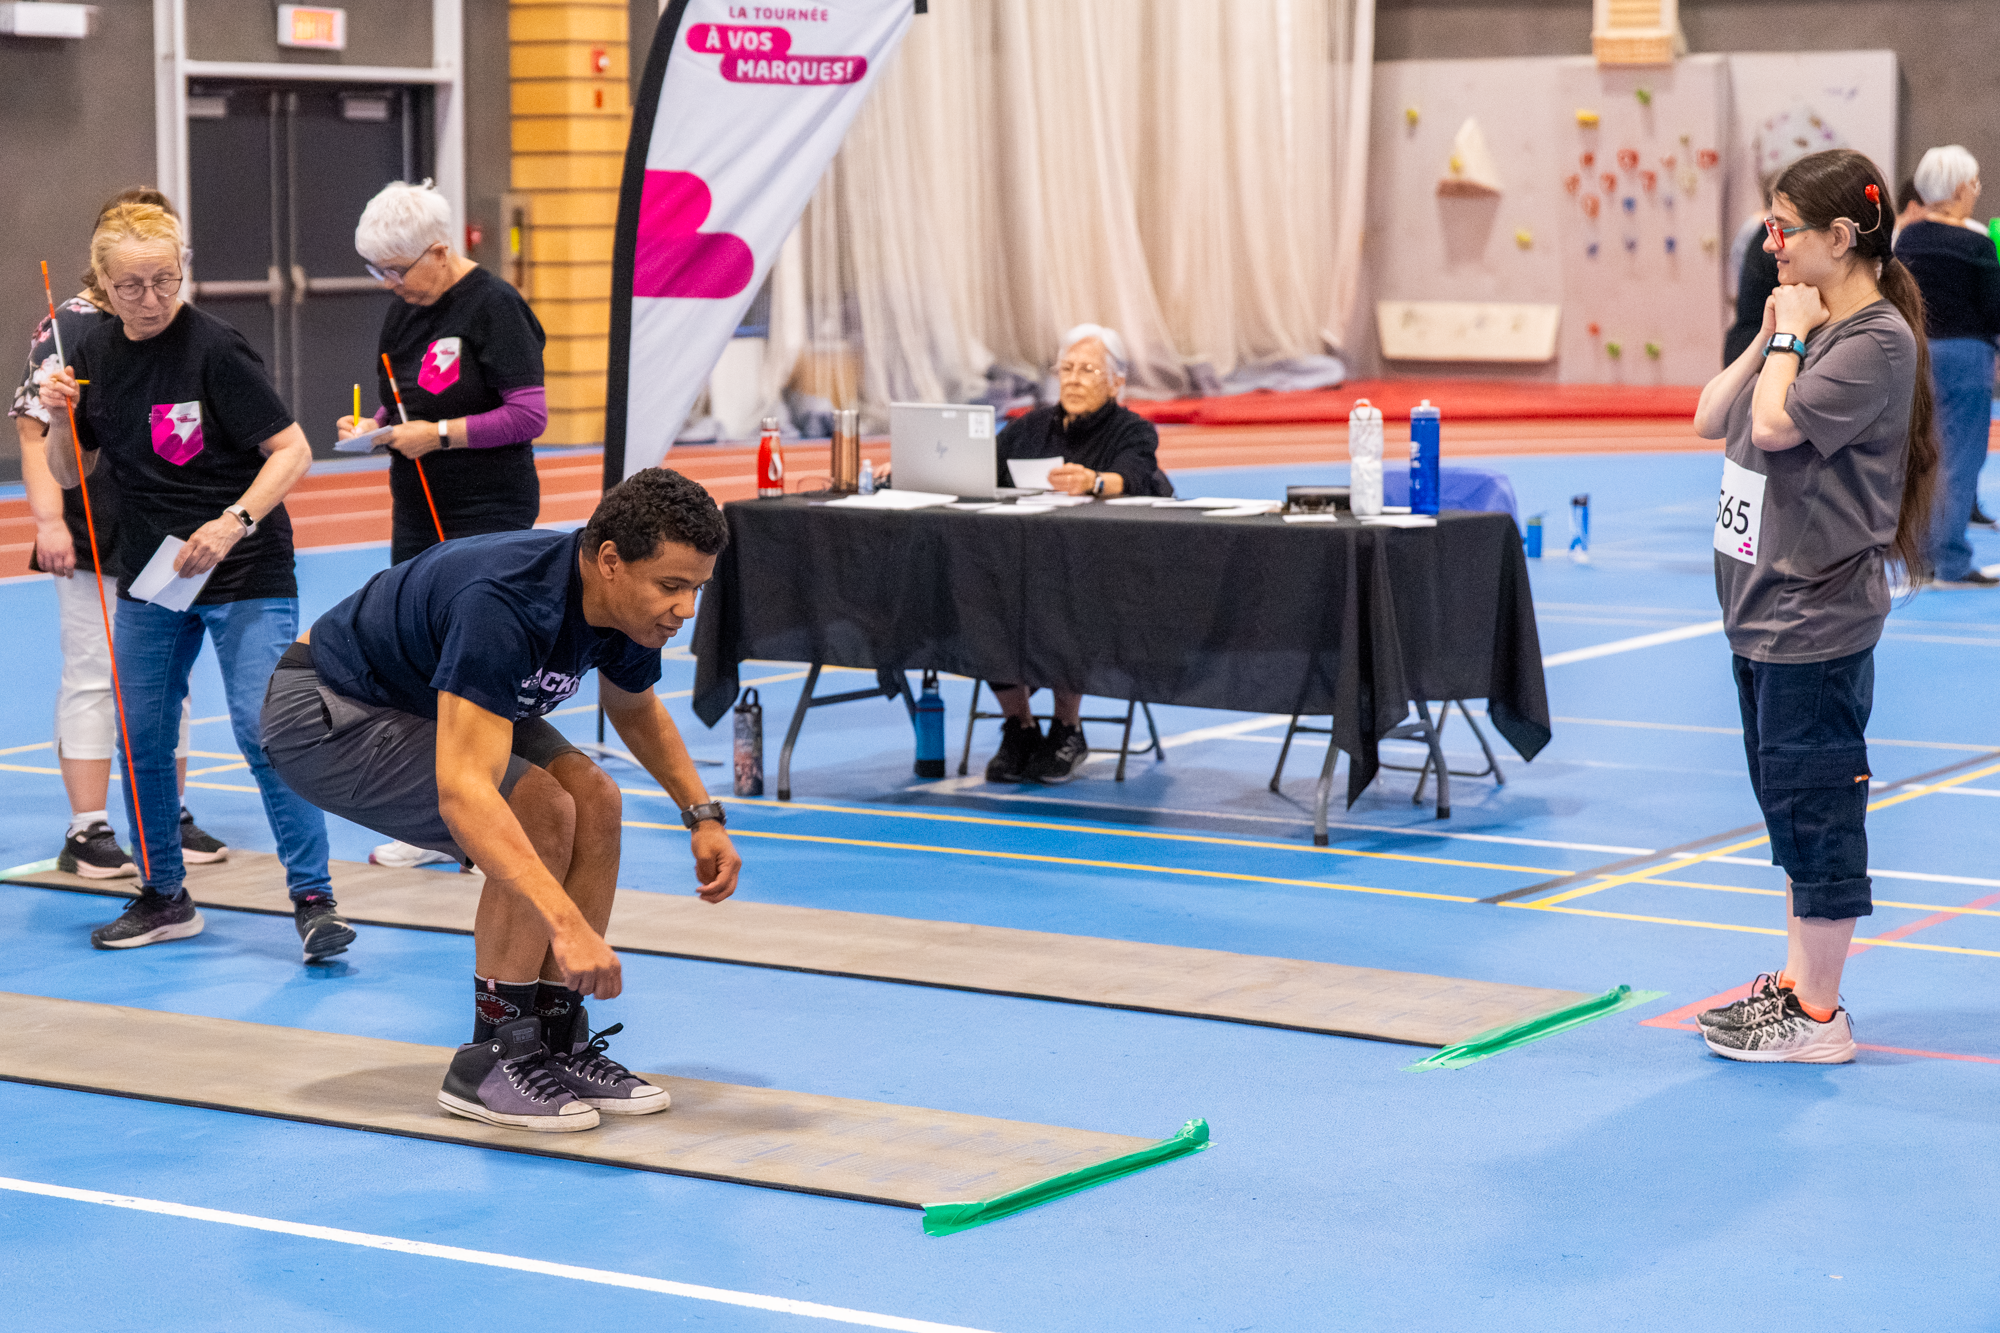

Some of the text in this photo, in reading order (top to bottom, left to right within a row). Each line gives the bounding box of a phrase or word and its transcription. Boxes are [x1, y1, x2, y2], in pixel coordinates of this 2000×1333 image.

[729, 6, 829, 22] LA TOURNÉE
[705, 25, 774, 51] À VOS
[736, 59, 853, 83] MARQUES!
